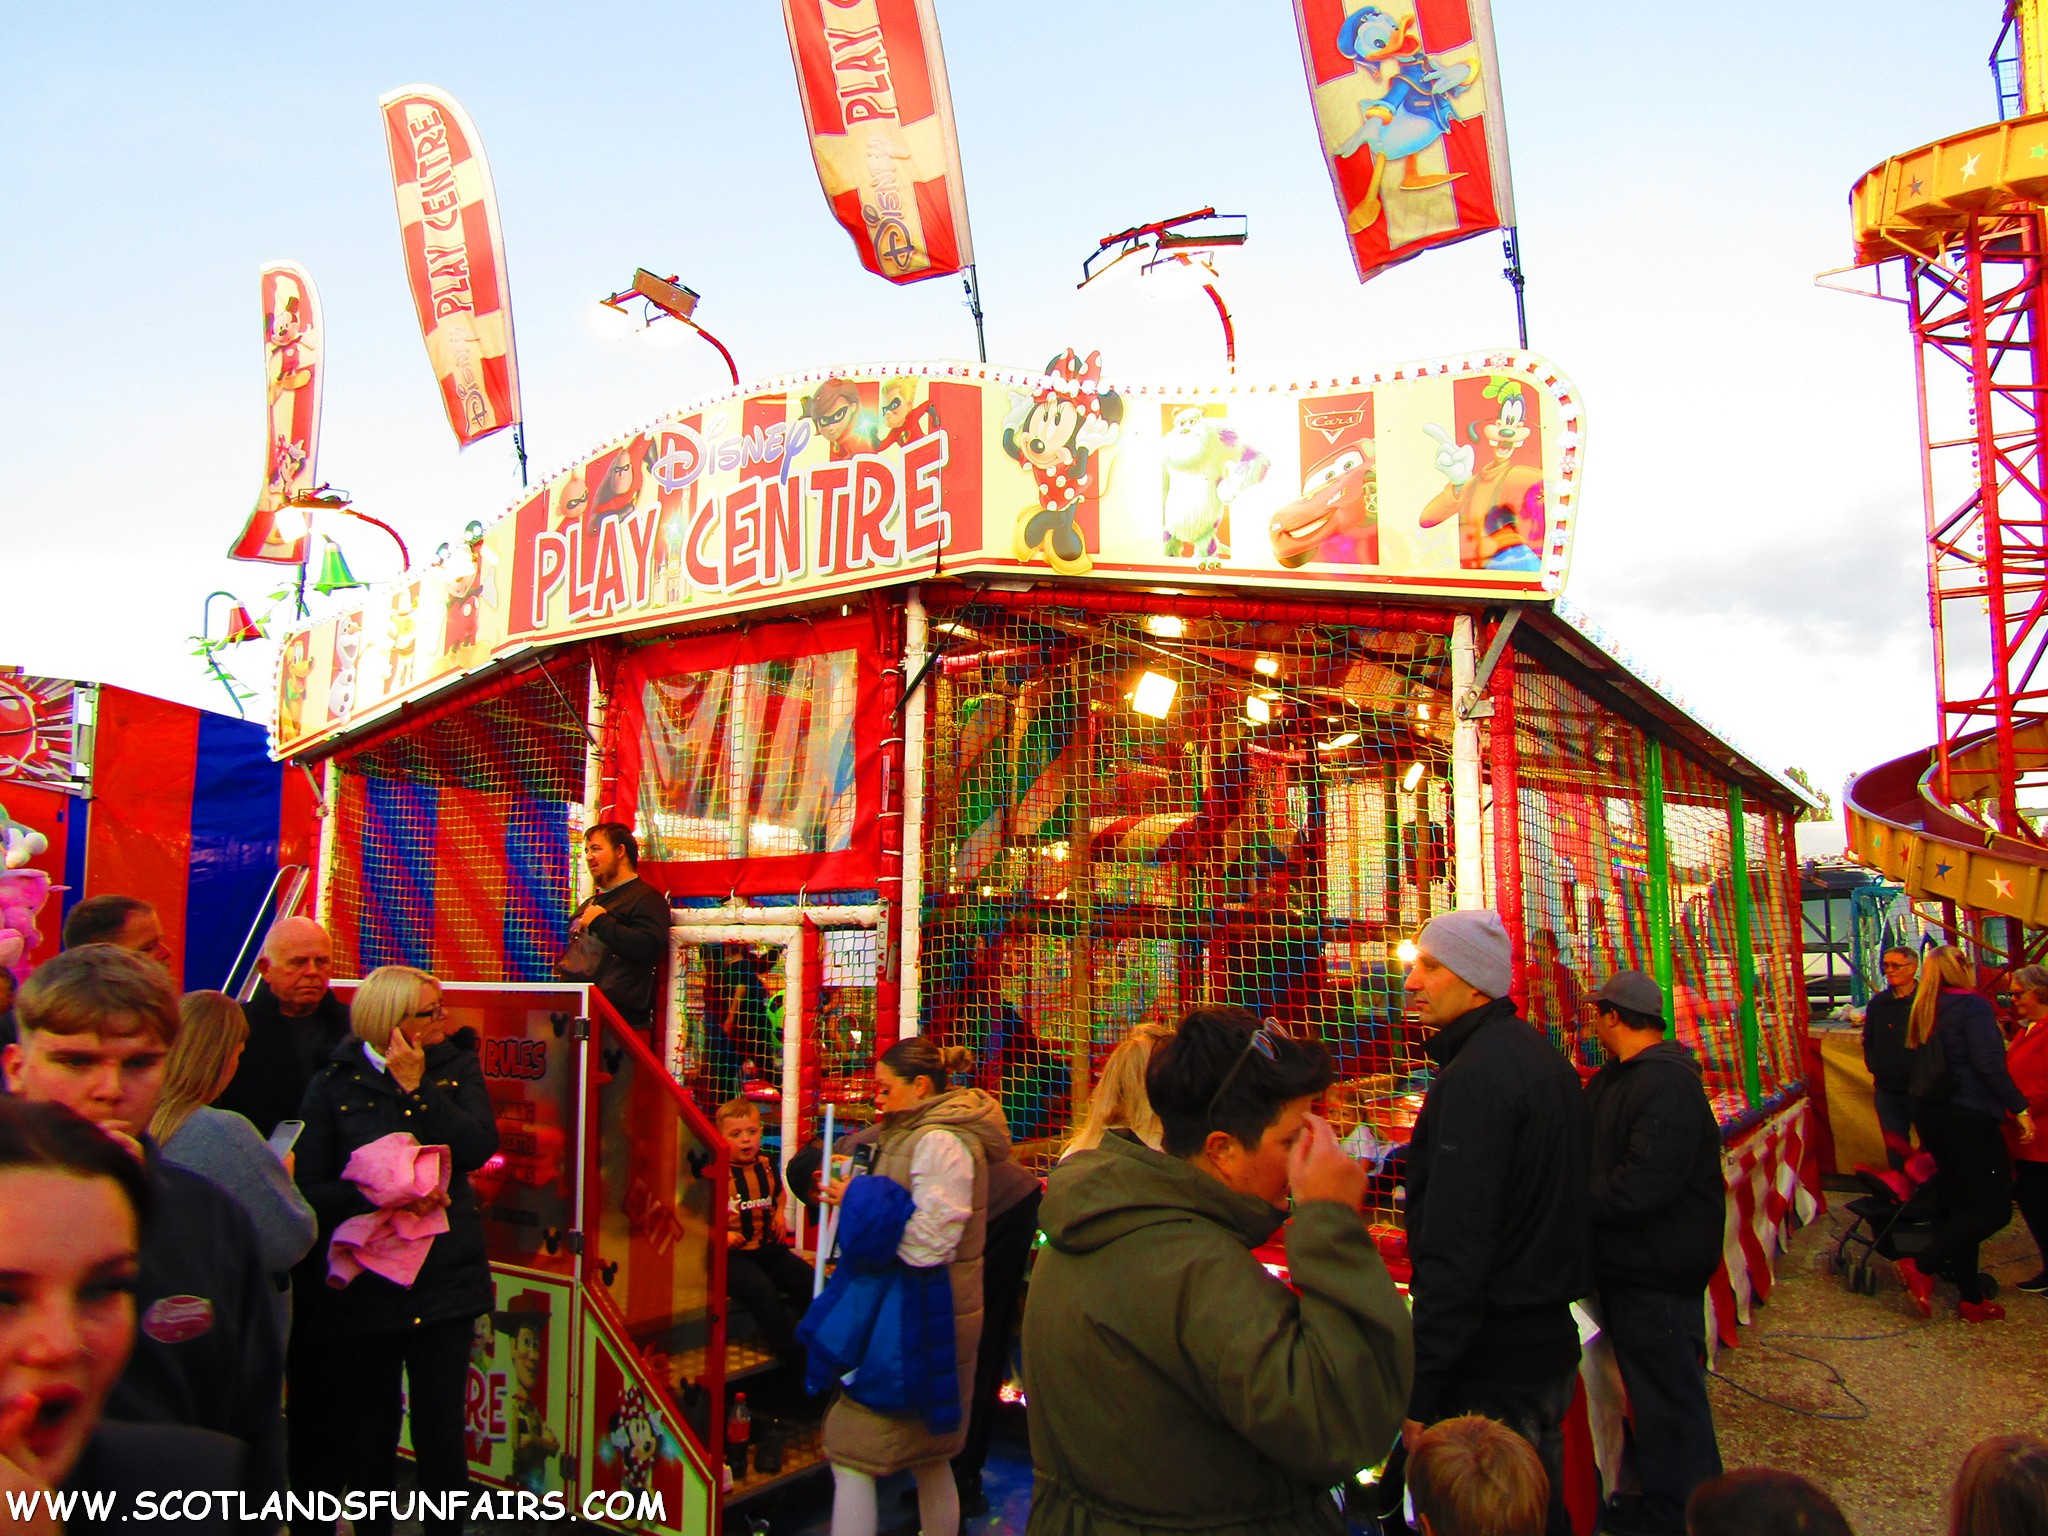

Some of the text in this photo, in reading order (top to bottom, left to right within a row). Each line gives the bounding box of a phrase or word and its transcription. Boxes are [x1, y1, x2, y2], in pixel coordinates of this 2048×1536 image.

[823, 24, 900, 126] PLAY
[409, 107, 475, 320] PLAY CENTRE
[1311, 415, 1355, 427] Cars
[532, 430, 951, 630] PLAY CENTRE
[484, 1039, 547, 1080] RULES
